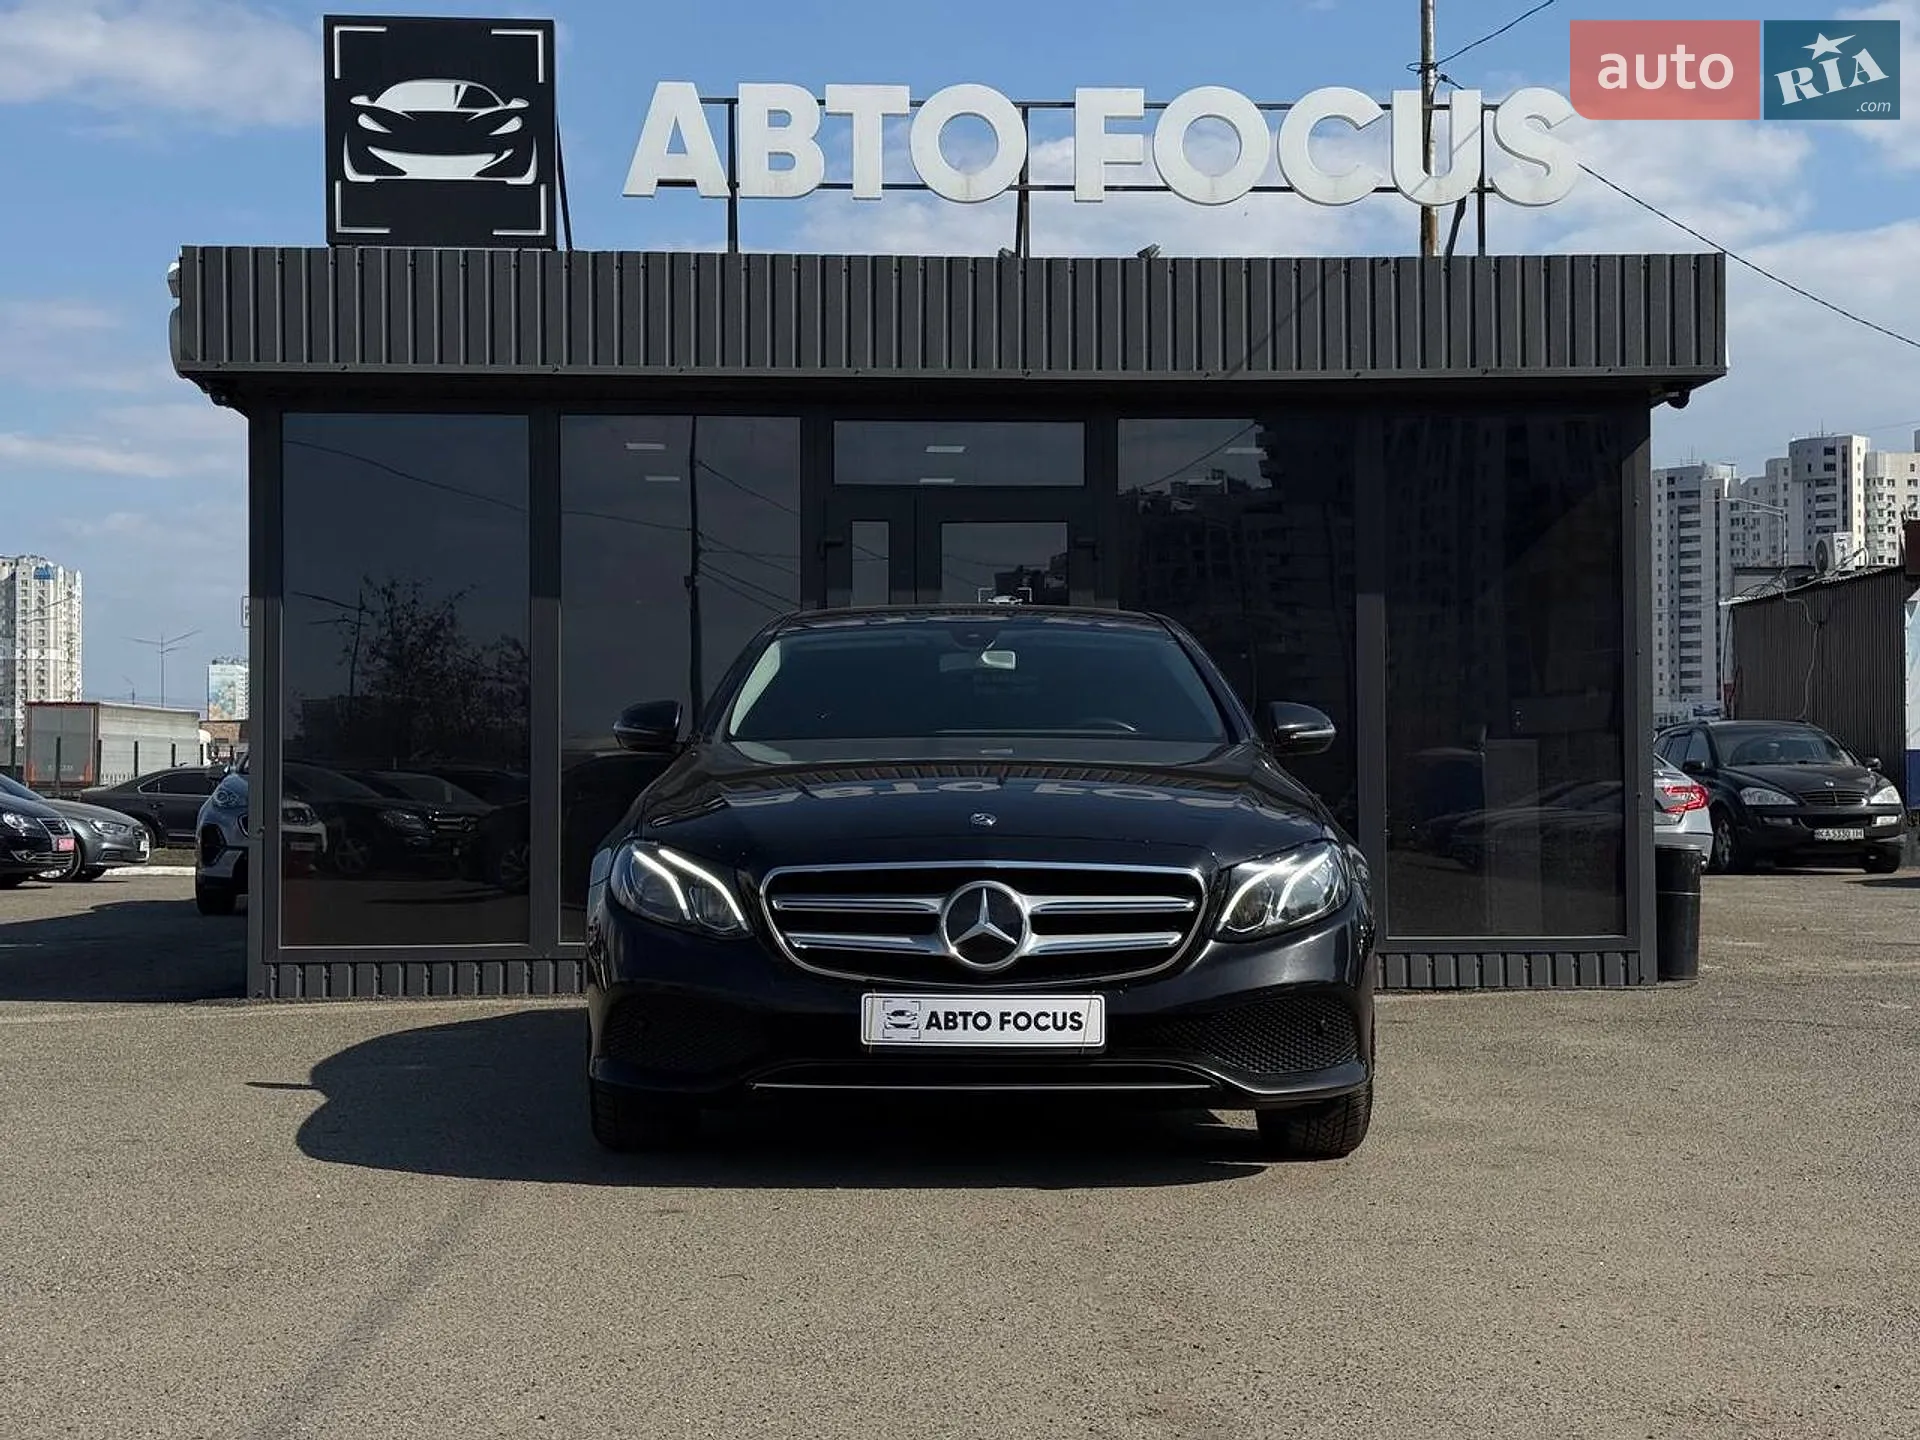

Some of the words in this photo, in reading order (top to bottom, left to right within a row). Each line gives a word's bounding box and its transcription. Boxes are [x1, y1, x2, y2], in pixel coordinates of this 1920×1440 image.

[623, 81, 1028, 203] АВТО
[1074, 86, 1581, 206] FOCUS
[925, 1011, 992, 1031] АВТО
[999, 1011, 1083, 1031] FOCUS
